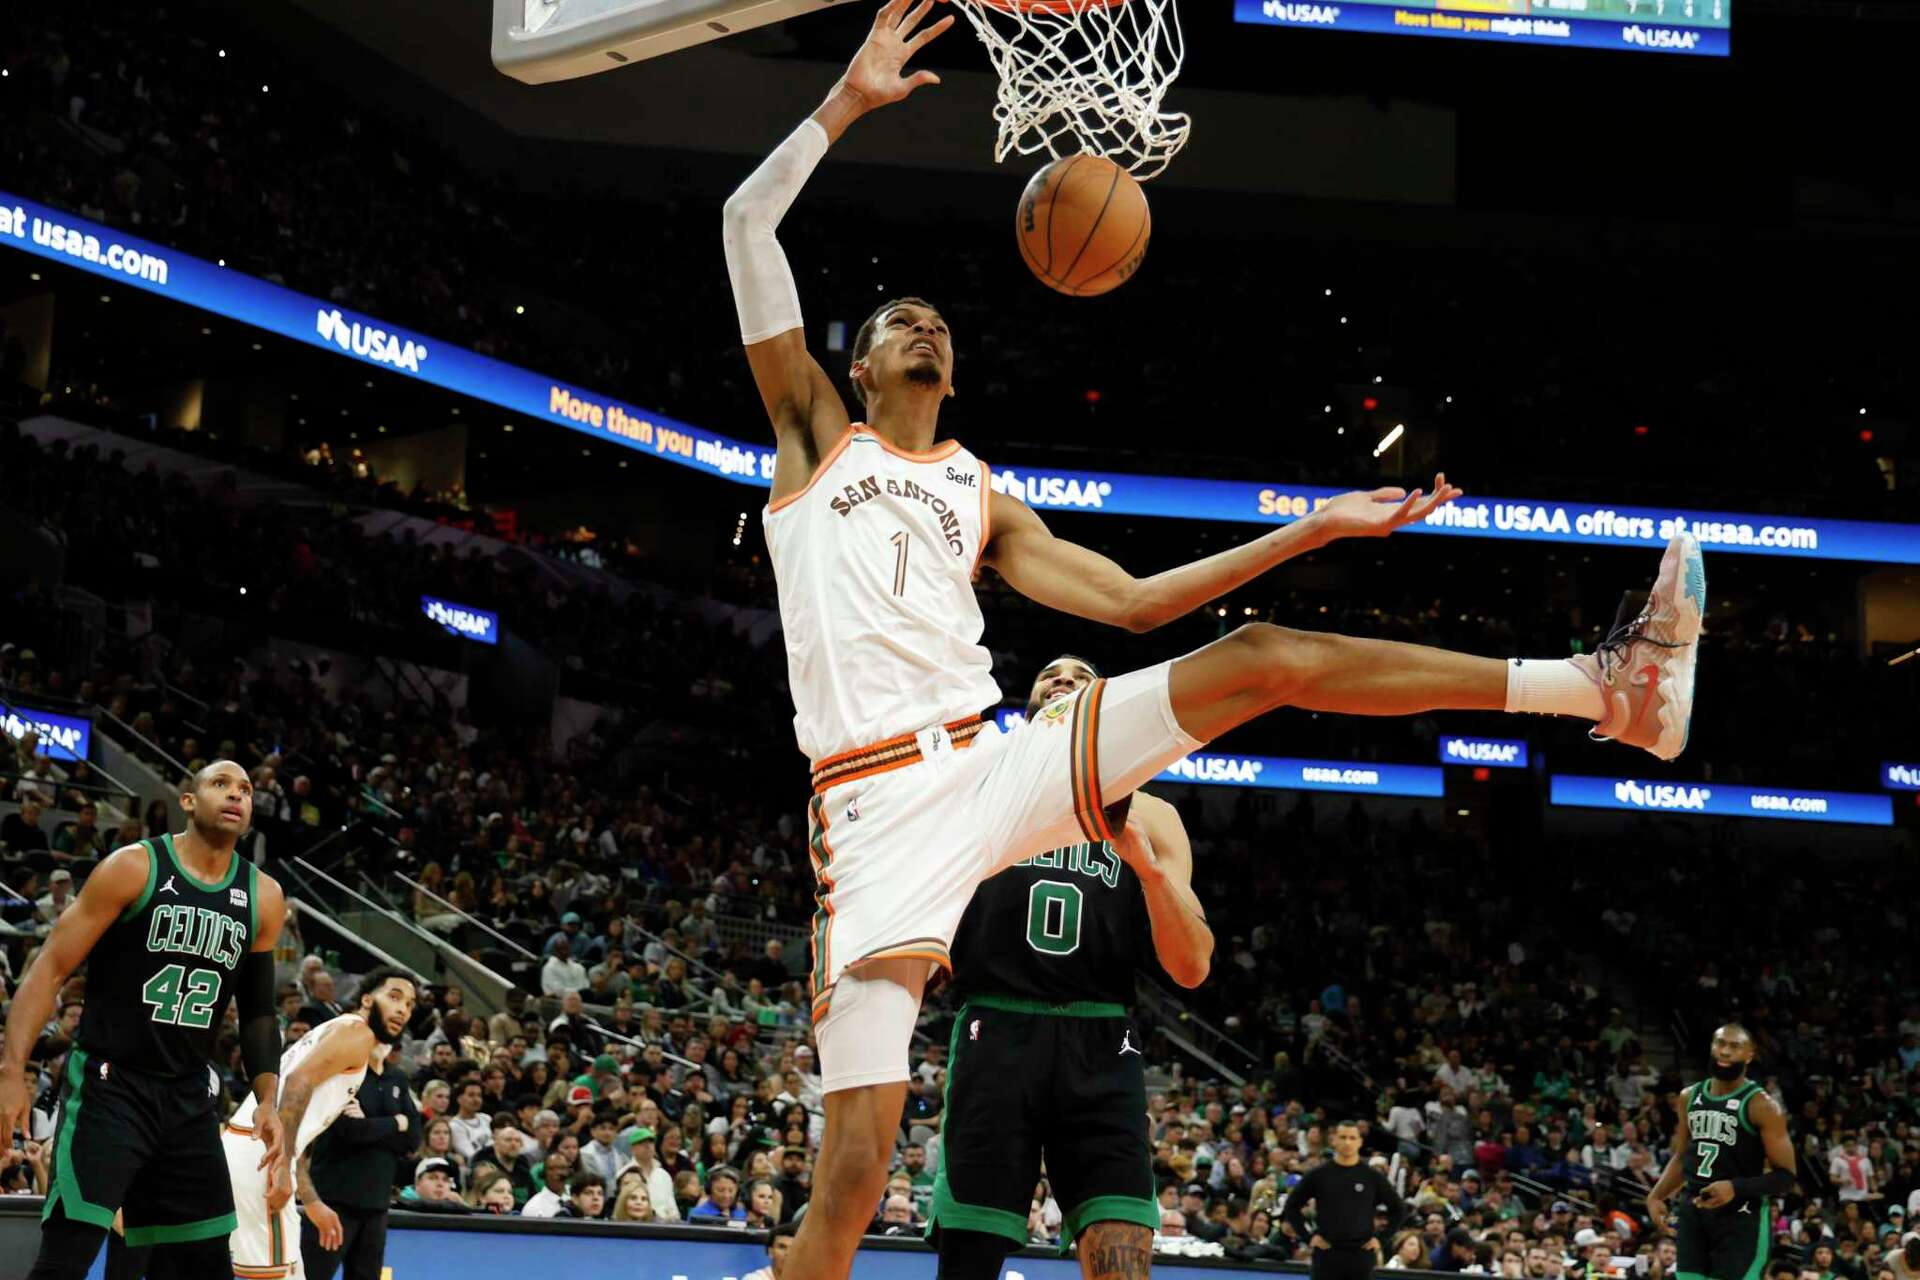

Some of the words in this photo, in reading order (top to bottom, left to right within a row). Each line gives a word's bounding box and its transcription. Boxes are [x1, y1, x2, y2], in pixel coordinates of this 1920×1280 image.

[0, 206, 26, 237] at
[33, 218, 168, 284] usaa.com
[550, 386, 603, 428] More
[607, 406, 653, 445] than
[656, 427, 694, 457] you
[696, 440, 756, 477] might
[945, 467, 976, 488] Self.
[1258, 489, 1308, 516] See
[830, 475, 881, 518] SAN
[887, 479, 963, 557] ANTONIO
[1425, 500, 1489, 529] what
[1494, 504, 1571, 533] USAA
[1576, 510, 1654, 538] offers
[1658, 516, 1687, 541] at
[1692, 521, 1818, 550] usaa.com
[890, 531, 910, 597] 1
[1302, 767, 1378, 785] usaa.com
[1751, 795, 1827, 813] usaa.com
[146, 904, 247, 970] CELTICS
[1026, 879, 1083, 955] 0
[142, 963, 222, 1029] 42
[1696, 1141, 1720, 1178] 7
